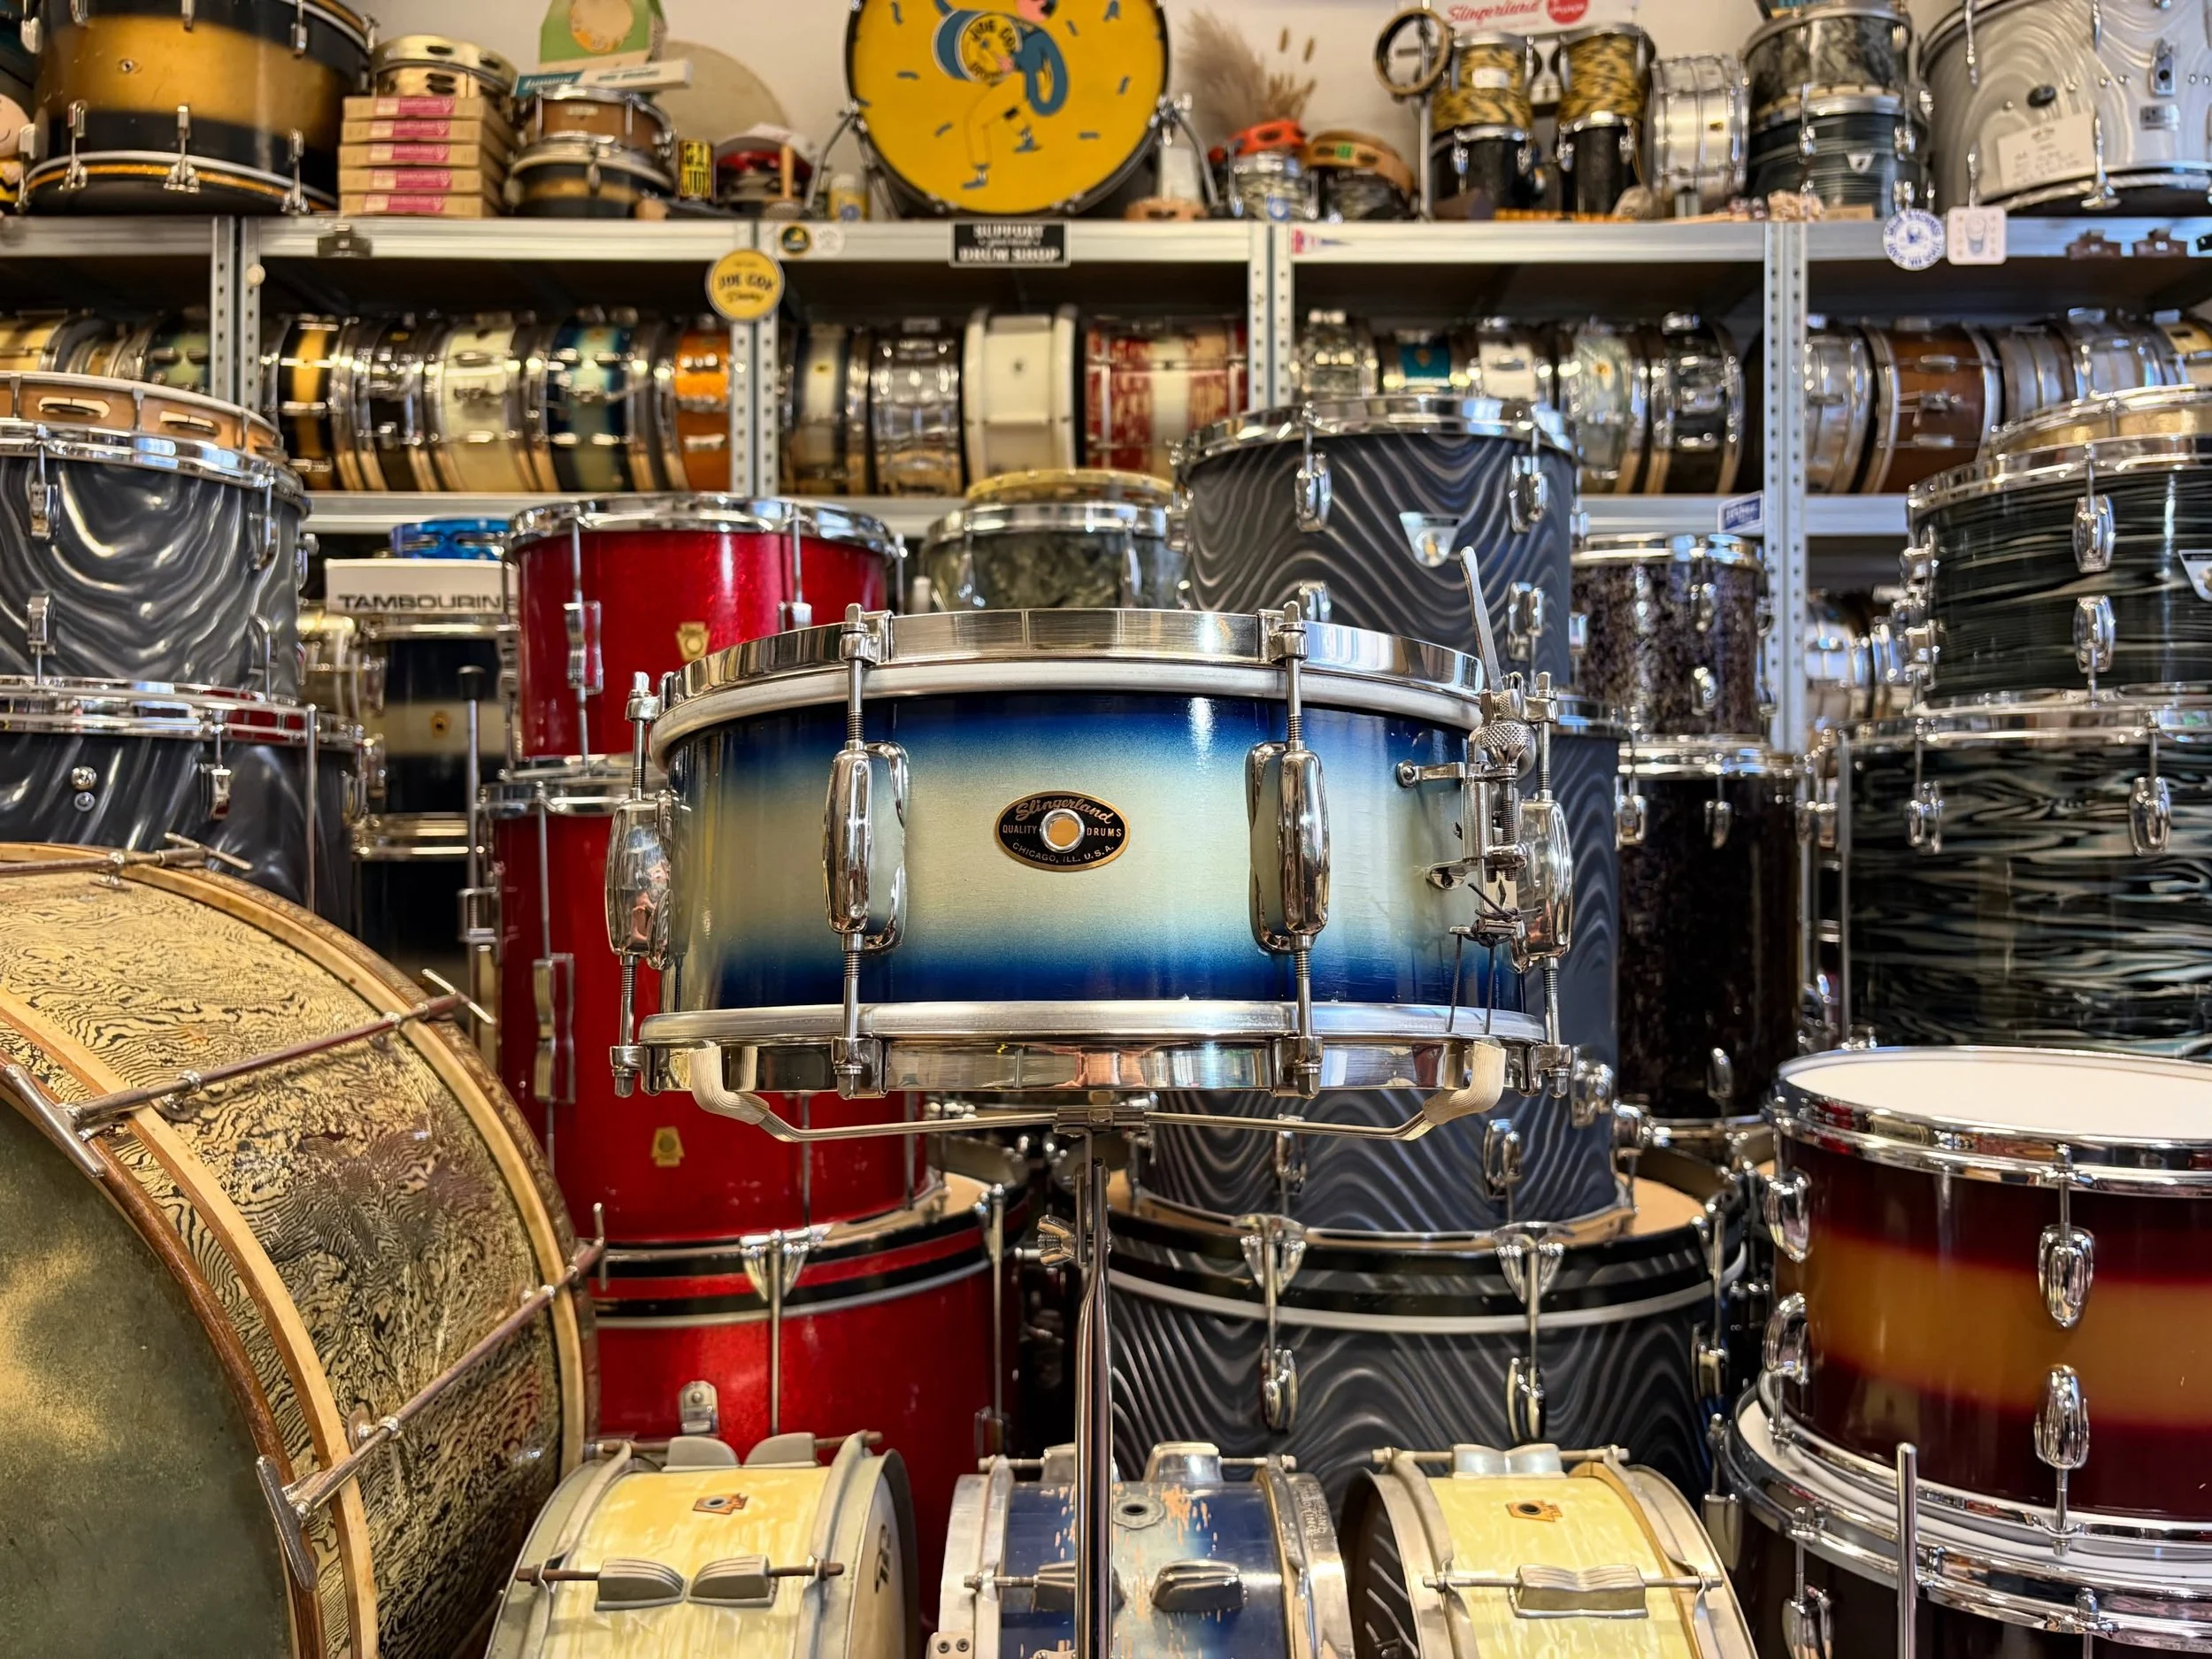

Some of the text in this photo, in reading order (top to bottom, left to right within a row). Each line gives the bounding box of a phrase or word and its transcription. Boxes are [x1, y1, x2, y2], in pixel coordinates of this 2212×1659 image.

[1448, 0, 1541, 26] Slingerland
[1015, 798, 1116, 825] Slingerland
[1002, 825, 1122, 837] QUALITY DRUMS
[1012, 842, 1059, 864] CHICAGO,
